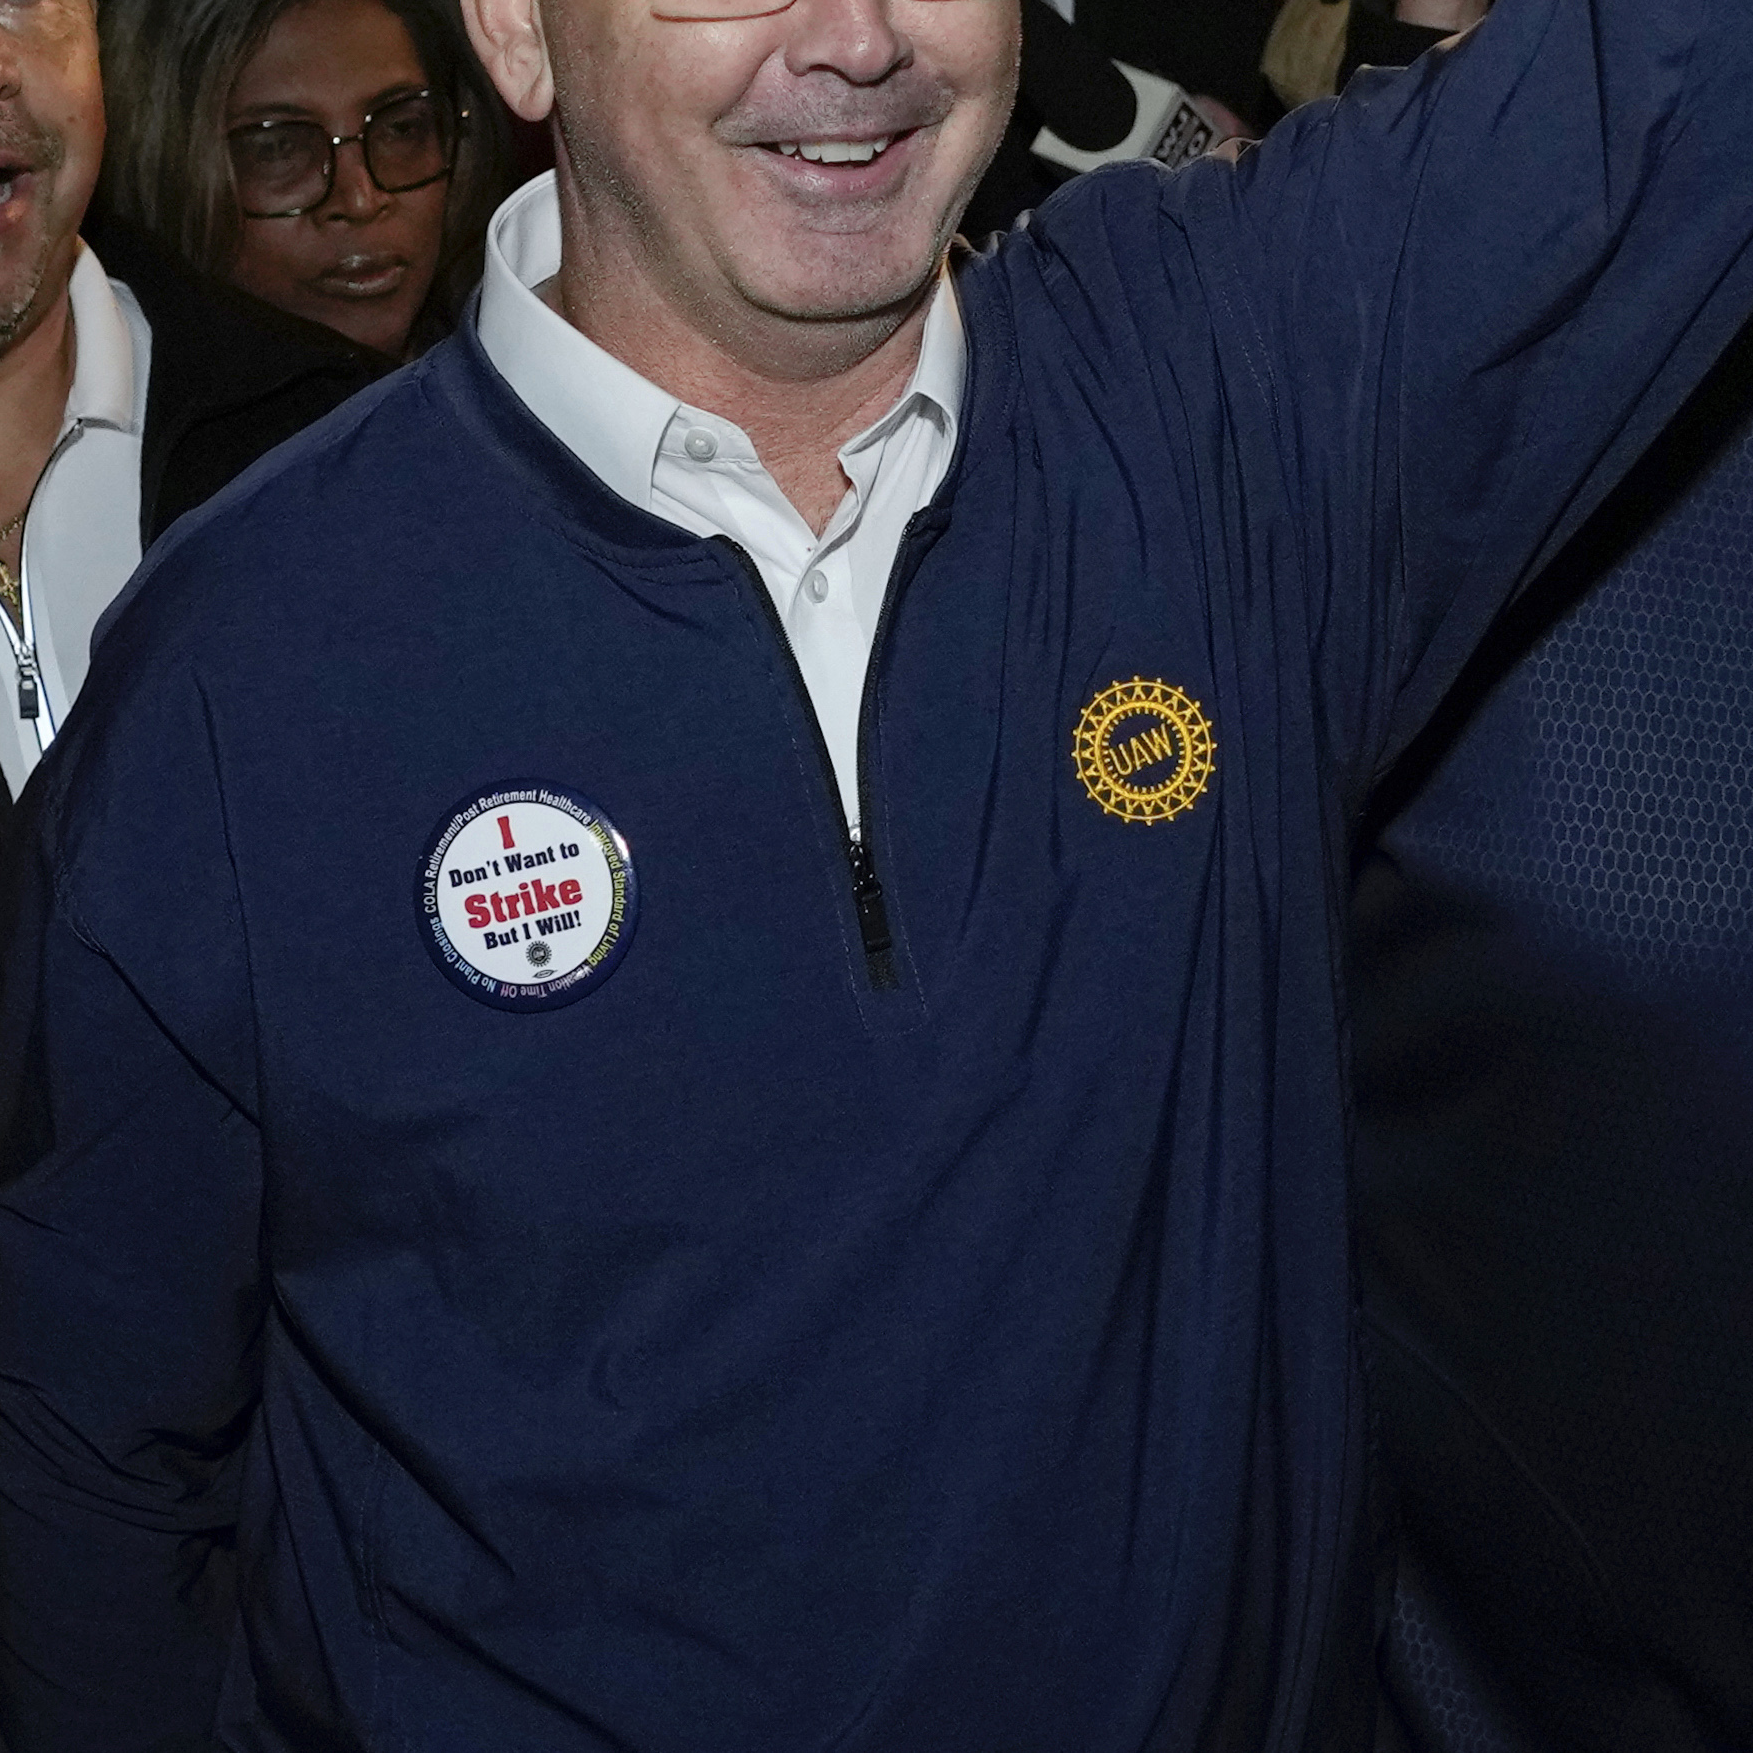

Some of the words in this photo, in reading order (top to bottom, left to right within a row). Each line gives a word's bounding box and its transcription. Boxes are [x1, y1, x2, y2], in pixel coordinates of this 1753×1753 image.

[1109, 723, 1173, 775] UAW
[477, 789, 537, 811] Retirement
[536, 790, 594, 824] Healthcare
[425, 803, 481, 878] Retirement/Post
[497, 815, 515, 850] I
[586, 817, 624, 870] Improved
[448, 859, 502, 888] Don't
[504, 848, 556, 873] Want
[561, 842, 580, 858] to
[424, 879, 436, 913] COLA
[464, 878, 583, 929] Strike
[613, 869, 628, 923] Standard
[427, 914, 462, 963] Closings
[483, 931, 520, 950] But
[523, 922, 531, 940] I
[538, 910, 582, 937] Will!
[607, 922, 622, 938] of
[585, 933, 617, 969] Living
[452, 957, 481, 984] Plant
[478, 975, 497, 992] No
[499, 983, 518, 997] Off
[519, 984, 547, 997] Time
